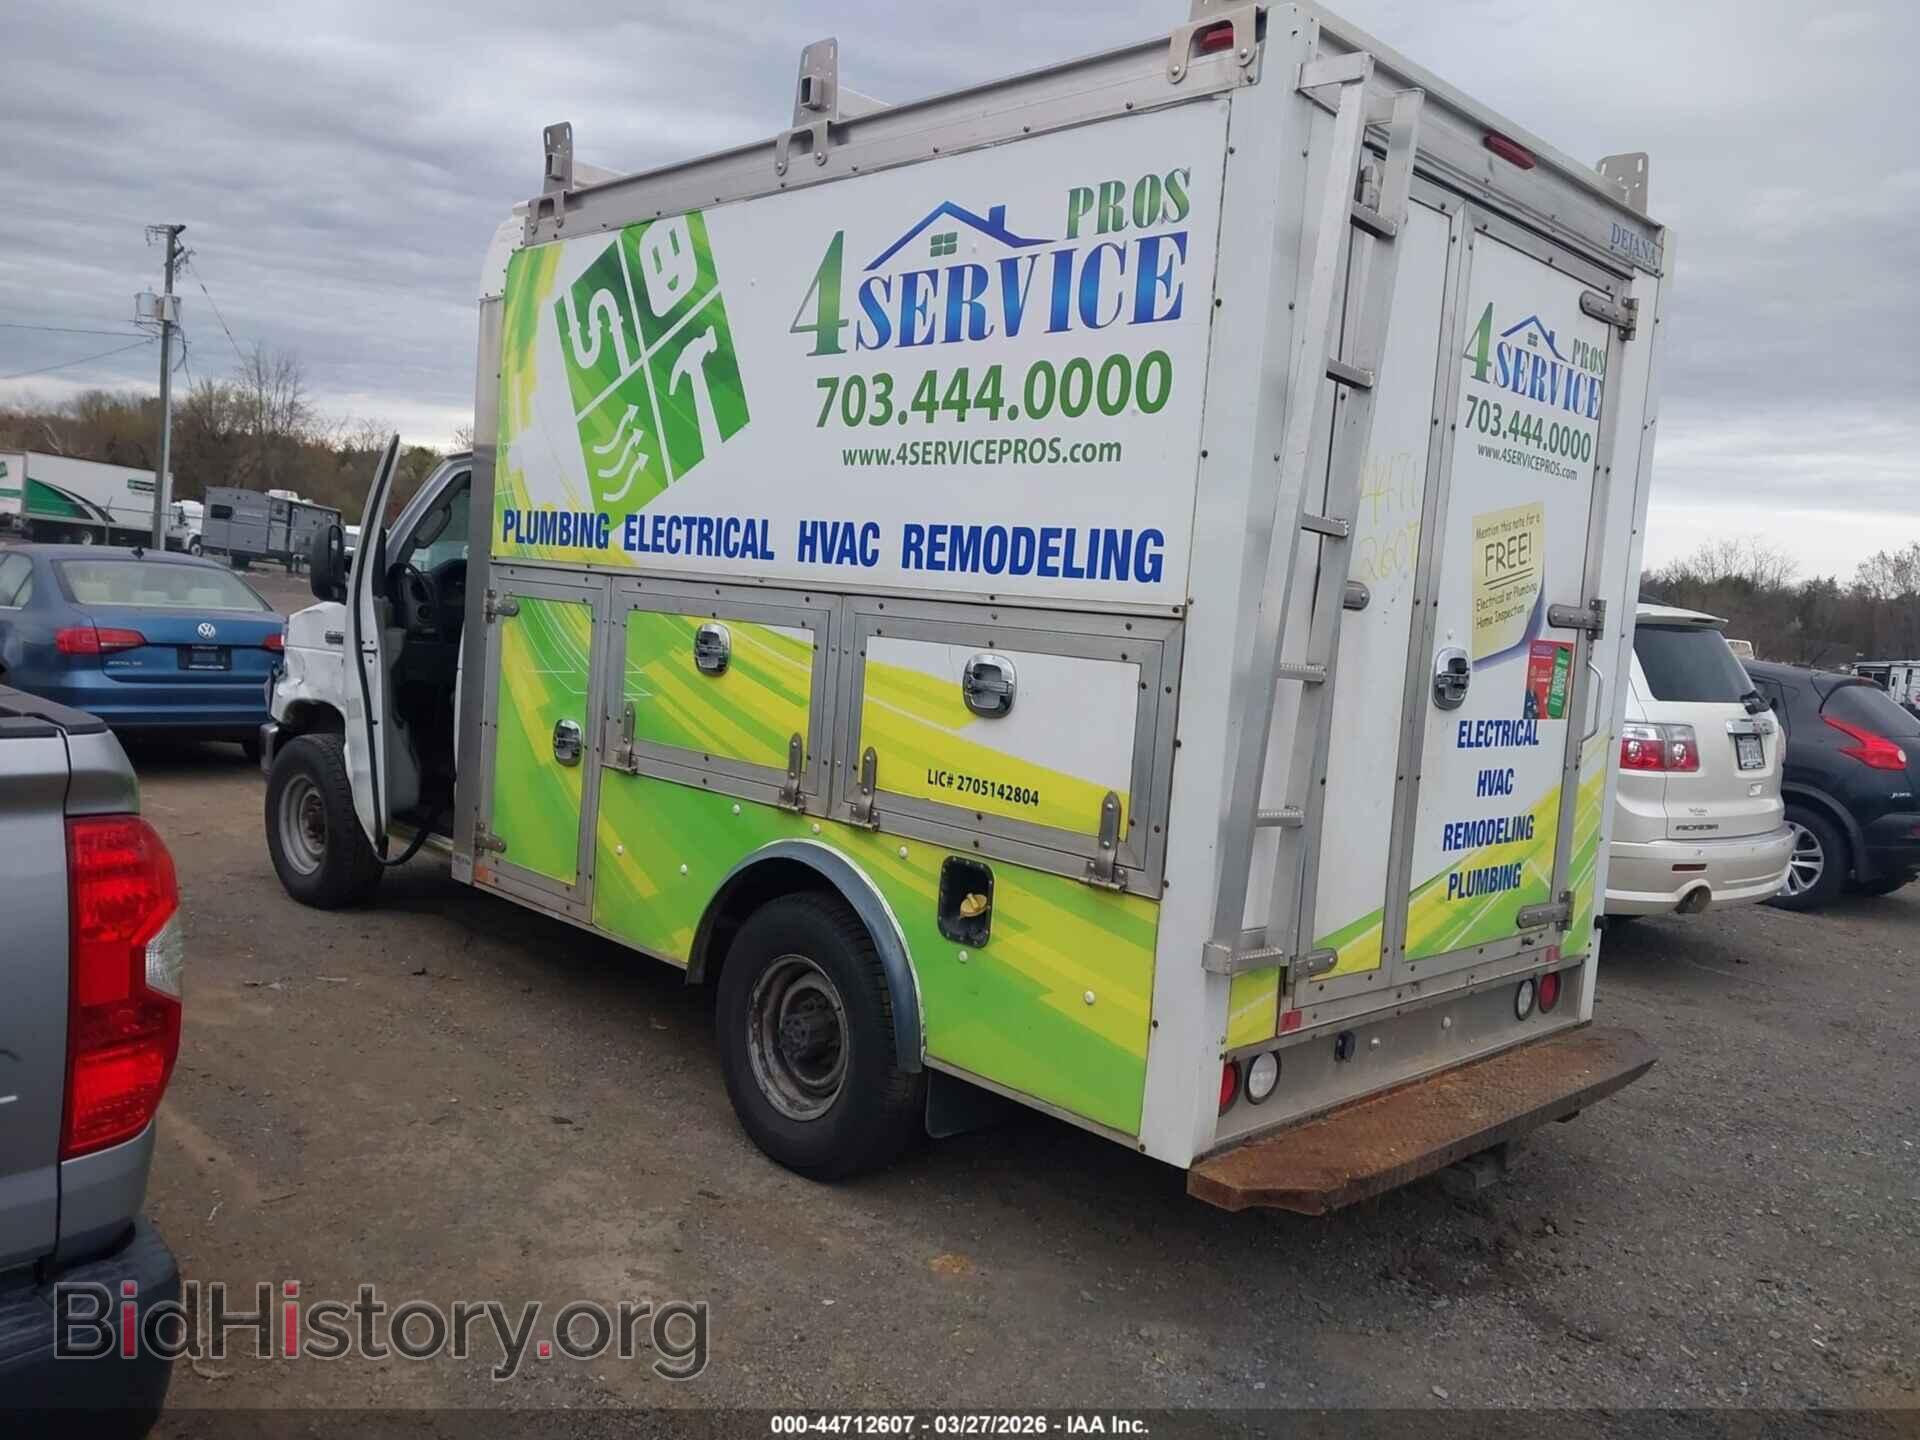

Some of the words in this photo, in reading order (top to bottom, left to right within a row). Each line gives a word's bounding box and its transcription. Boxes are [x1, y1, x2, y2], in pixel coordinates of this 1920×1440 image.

[1065, 168, 1190, 241] PROS
[789, 230, 849, 356] 4
[855, 231, 1188, 352] SERVICE
[1463, 301, 1493, 384] 4
[1494, 341, 1602, 421] SERVICE
[1571, 338, 1605, 376] PROS
[815, 349, 1173, 428] 703.444.0000
[1464, 394, 1592, 464] 703.444.0000
[842, 436, 1122, 466] www.4SERVICEPROS.com
[1477, 443, 1578, 481] www.4SERVICEPROS.com
[1500, 519, 1512, 532] this
[502, 510, 610, 549] PLUMBING
[623, 514, 774, 561] ELECTRICAL
[797, 521, 880, 567] HVAC
[901, 523, 1165, 583] REMODELING
[1485, 531, 1532, 577] FREE!
[1476, 590, 1505, 612] Electrical
[1476, 615, 1494, 629] Home
[1495, 604, 1525, 623] Inspection
[1457, 719, 1540, 748] ELECTRICAL
[927, 769, 954, 788] LIC#
[957, 775, 1040, 806] 2705142804
[1476, 767, 1515, 797] HVAC
[1442, 814, 1535, 851] REMODELING
[1447, 862, 1522, 900] PLUMBING
